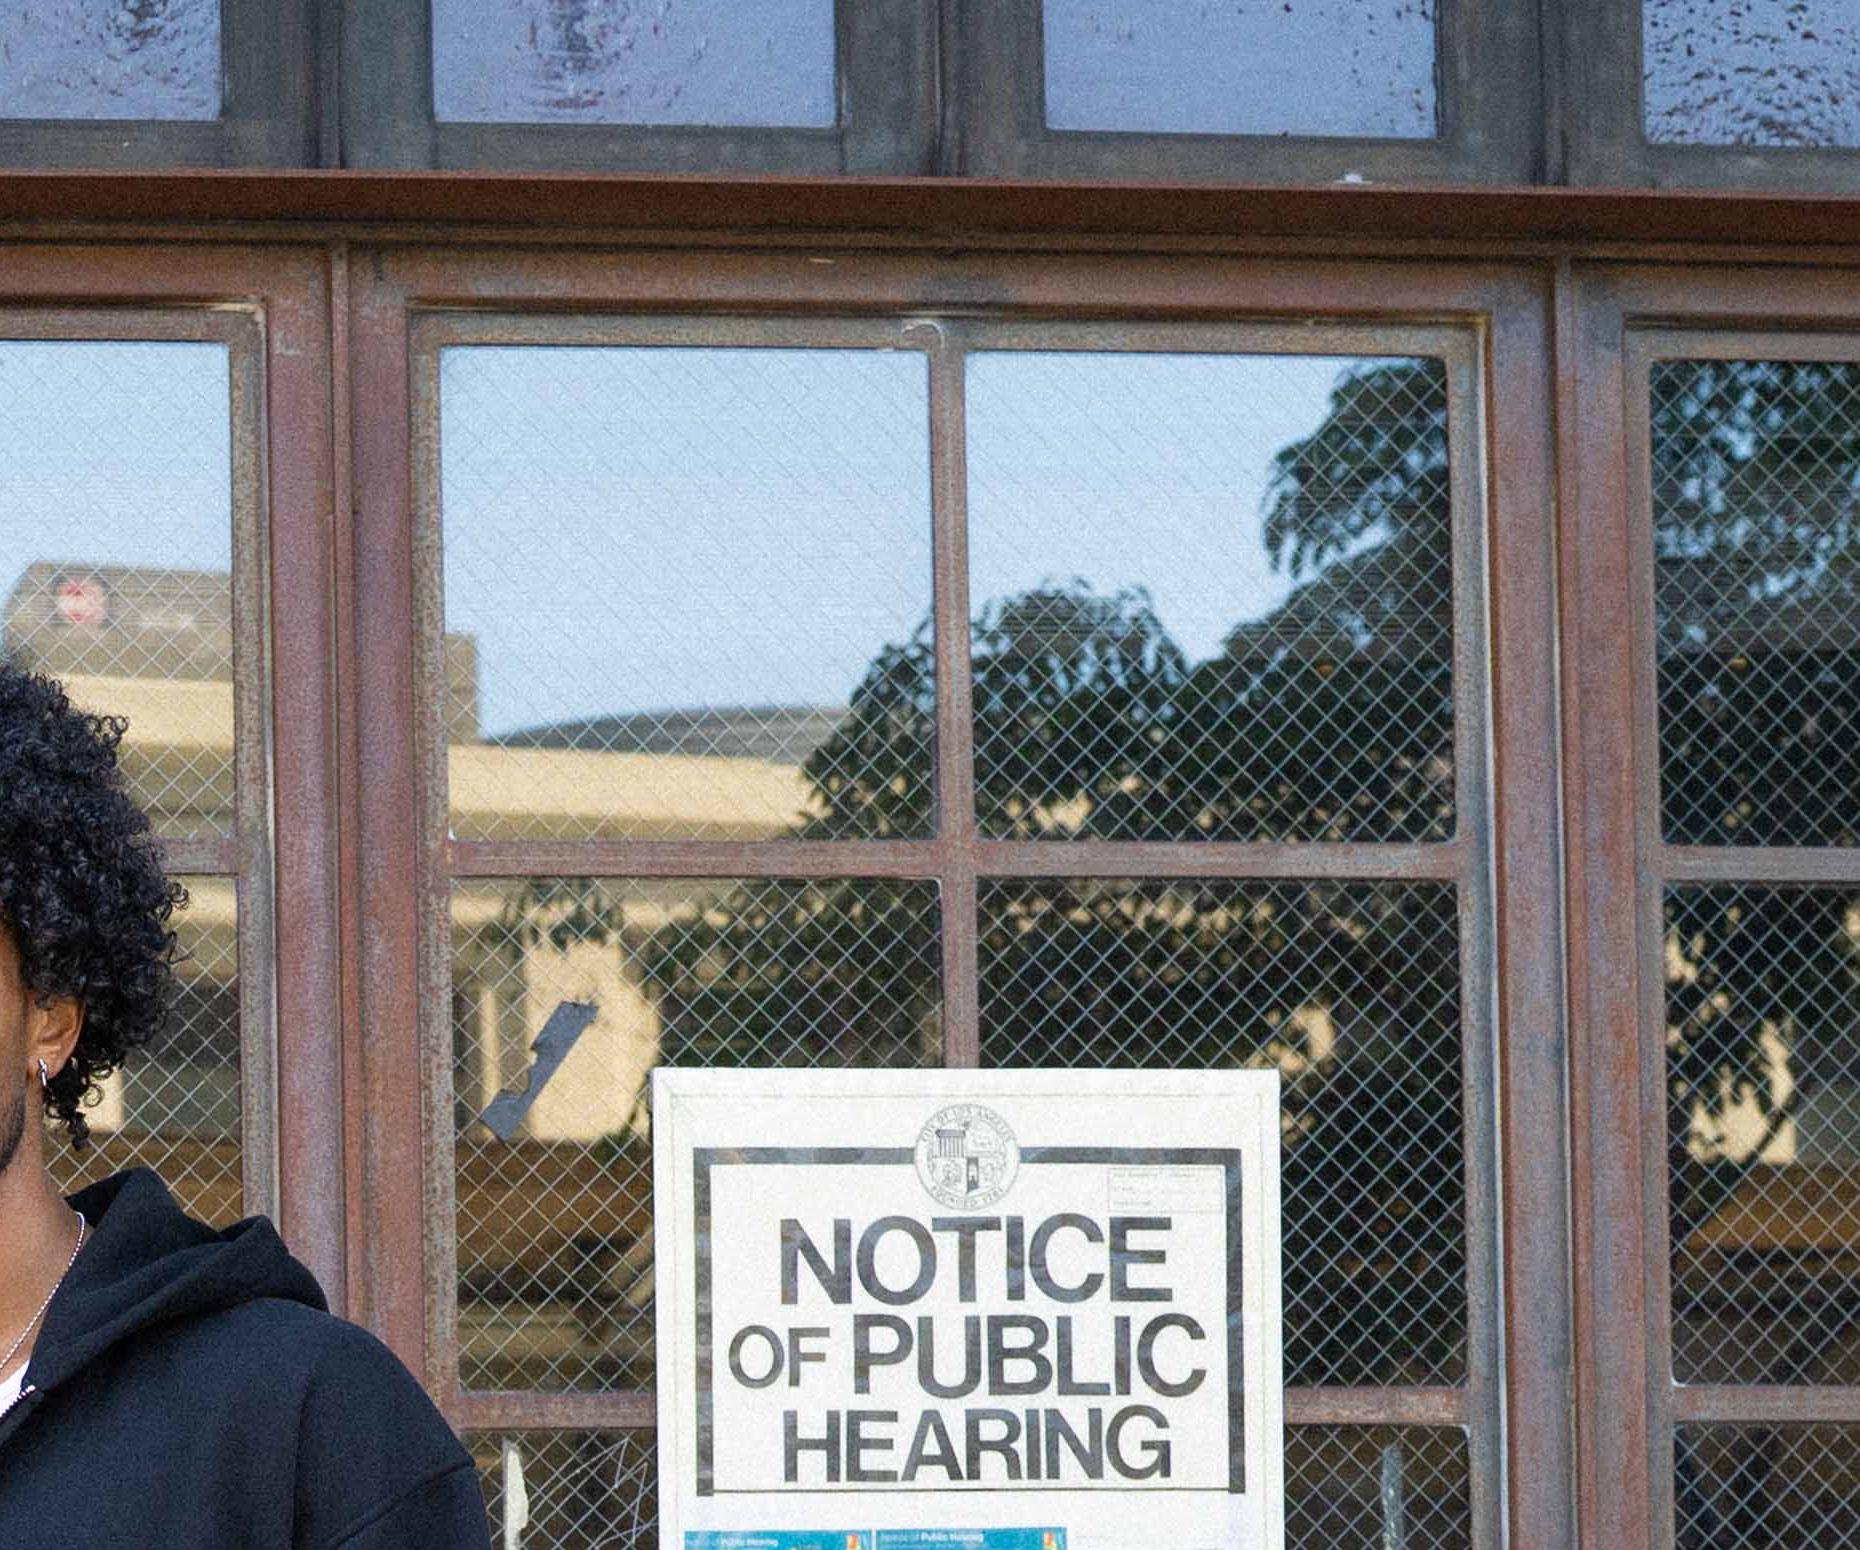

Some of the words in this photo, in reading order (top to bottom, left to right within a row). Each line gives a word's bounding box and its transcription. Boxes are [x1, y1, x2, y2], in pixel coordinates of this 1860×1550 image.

[780, 1213, 1173, 1305] NOTICE
[729, 1324, 830, 1389] OF
[853, 1313, 1207, 1400] PUBLIC
[783, 1405, 1172, 1483] HEARING
